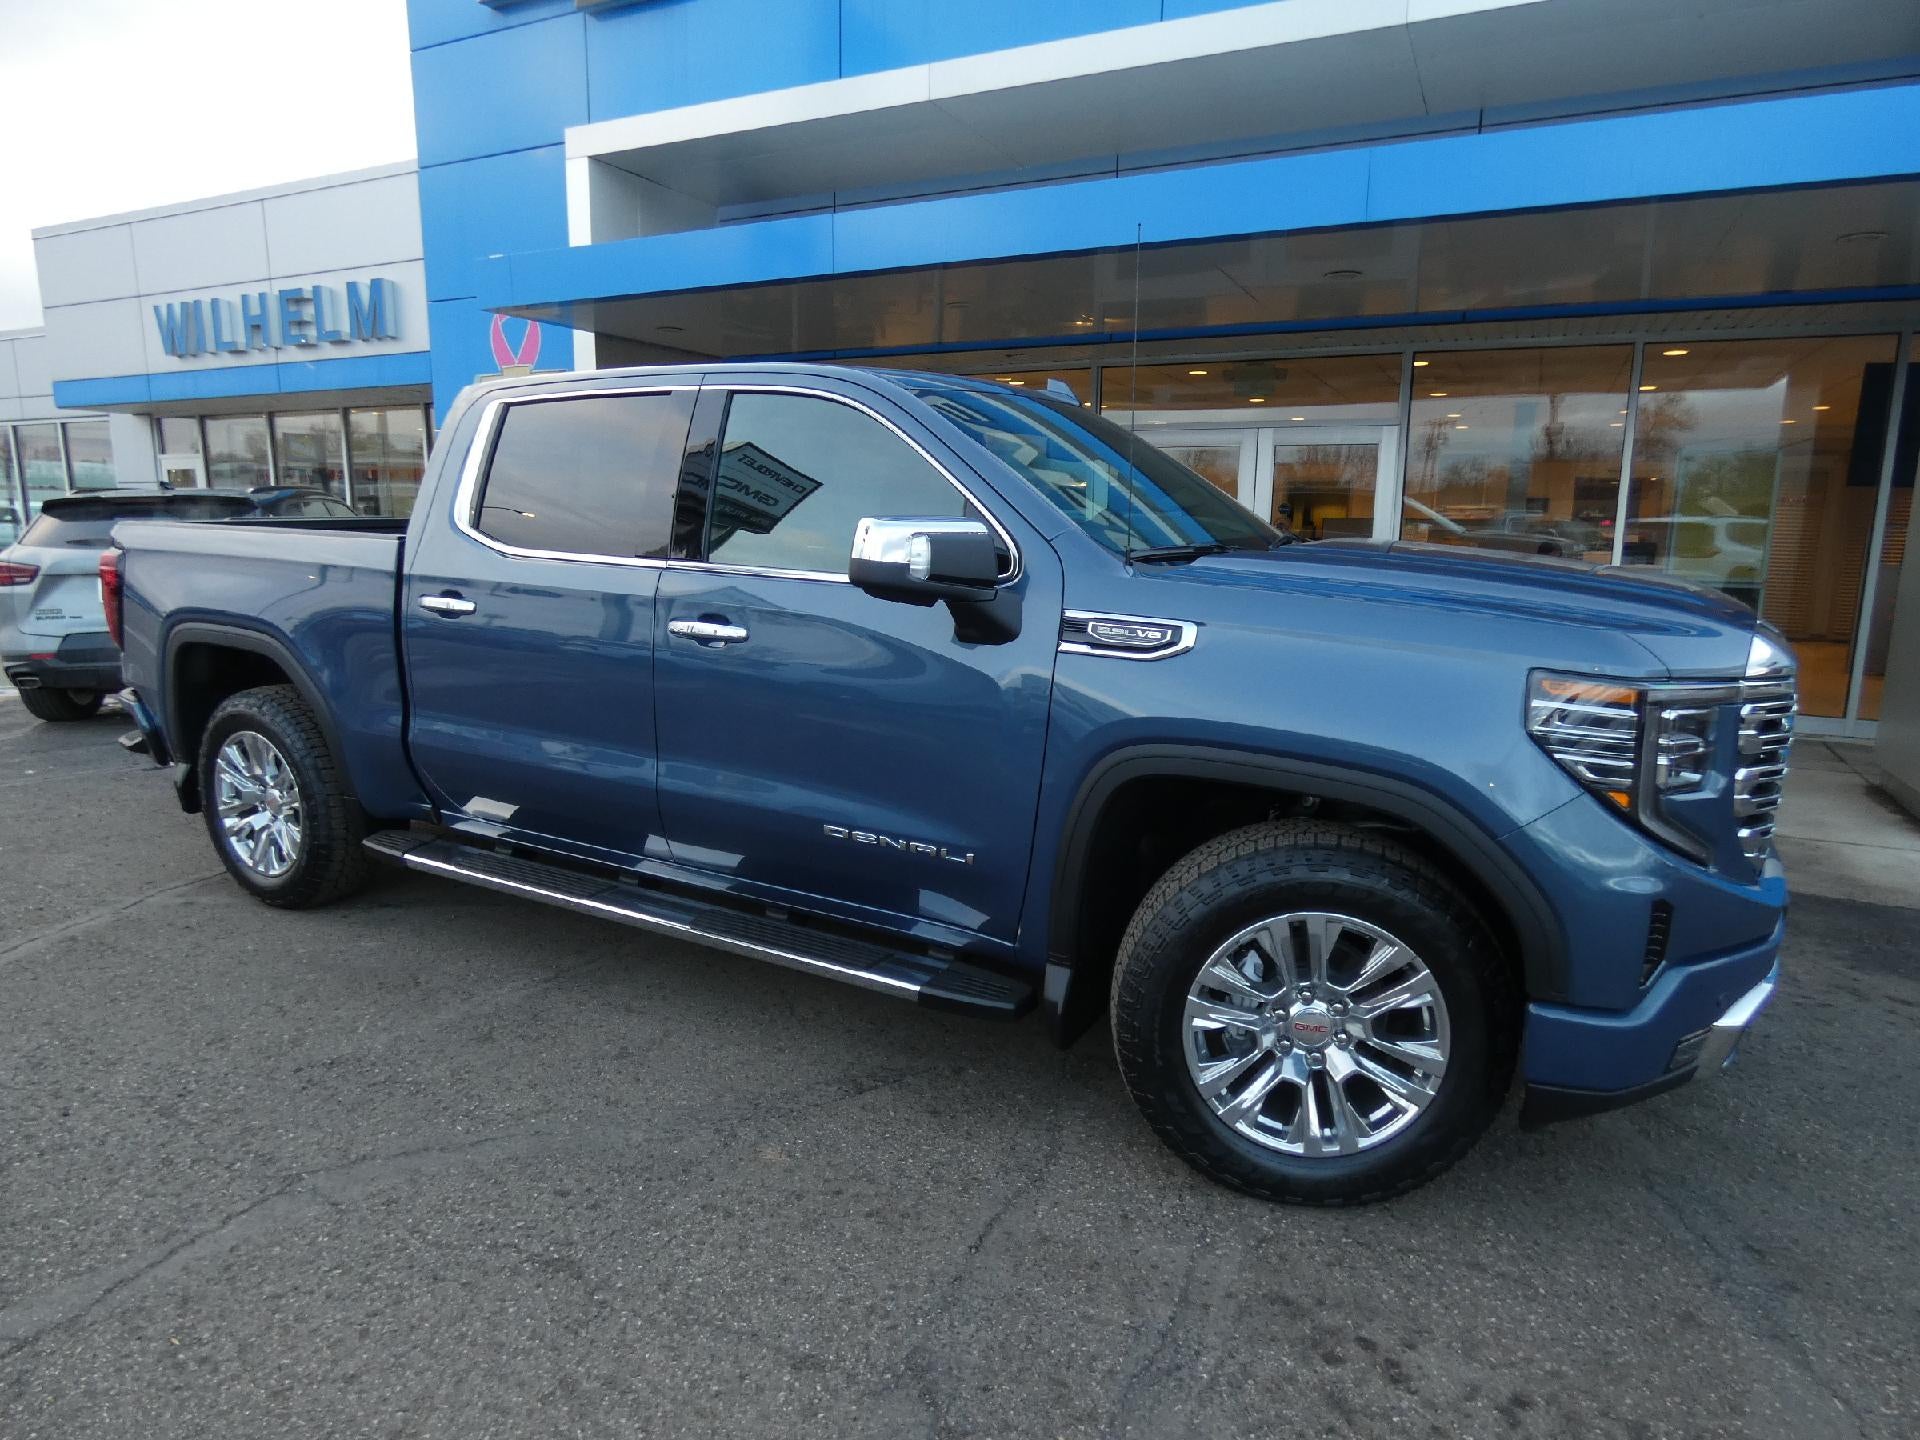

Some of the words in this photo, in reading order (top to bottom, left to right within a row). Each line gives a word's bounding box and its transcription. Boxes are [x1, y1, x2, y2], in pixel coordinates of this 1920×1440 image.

[153, 277, 397, 358] WILHELM
[823, 824, 975, 865] DENALI
[1294, 1022, 1329, 1033] GMC
